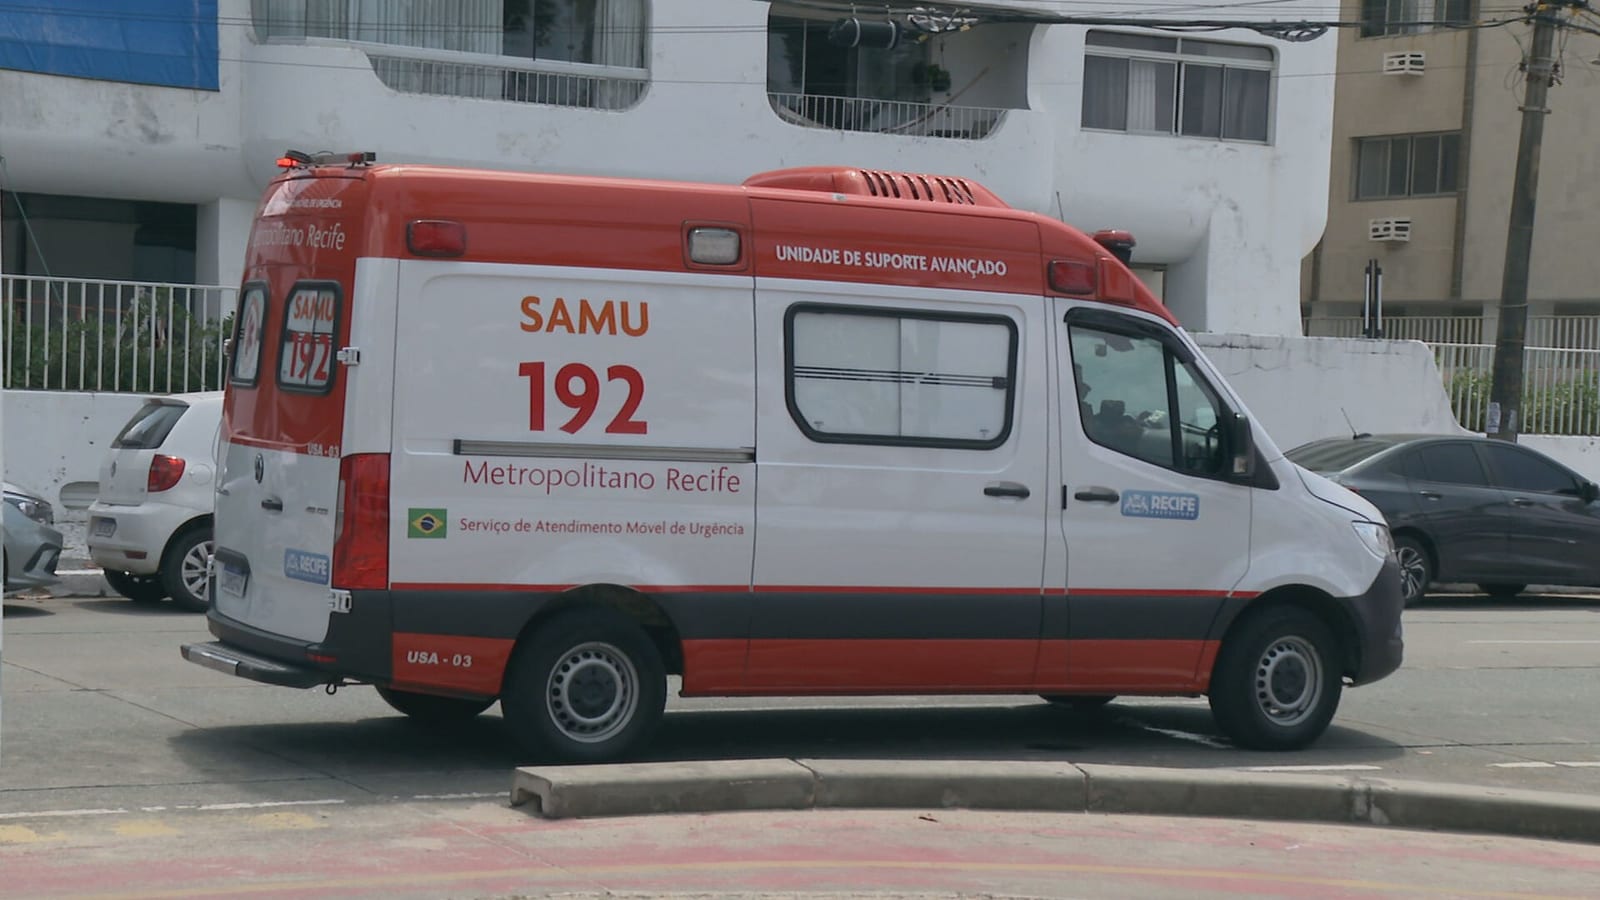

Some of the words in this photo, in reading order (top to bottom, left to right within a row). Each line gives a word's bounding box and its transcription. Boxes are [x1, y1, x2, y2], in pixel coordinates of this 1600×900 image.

[306, 222, 345, 250] Recife
[776, 245, 840, 265] UNIDADE
[844, 251, 862, 266] DE
[865, 252, 927, 271] SUPORTE
[930, 257, 1007, 278] AVANÇADO
[294, 295, 333, 321] SAMU
[520, 296, 649, 337] SAMU
[290, 332, 330, 380] 192
[518, 361, 648, 435] 192
[463, 460, 655, 495] Metropolitano
[666, 466, 740, 493] Recife
[1151, 495, 1195, 512] RECIFE
[460, 518, 510, 534] Serviço
[514, 518, 531, 532] de
[535, 520, 622, 534] Atendimento
[626, 520, 666, 534] Móvel
[670, 521, 686, 535] de
[690, 522, 744, 538] Urgência
[407, 650, 439, 665] USA
[452, 654, 473, 667] 03
